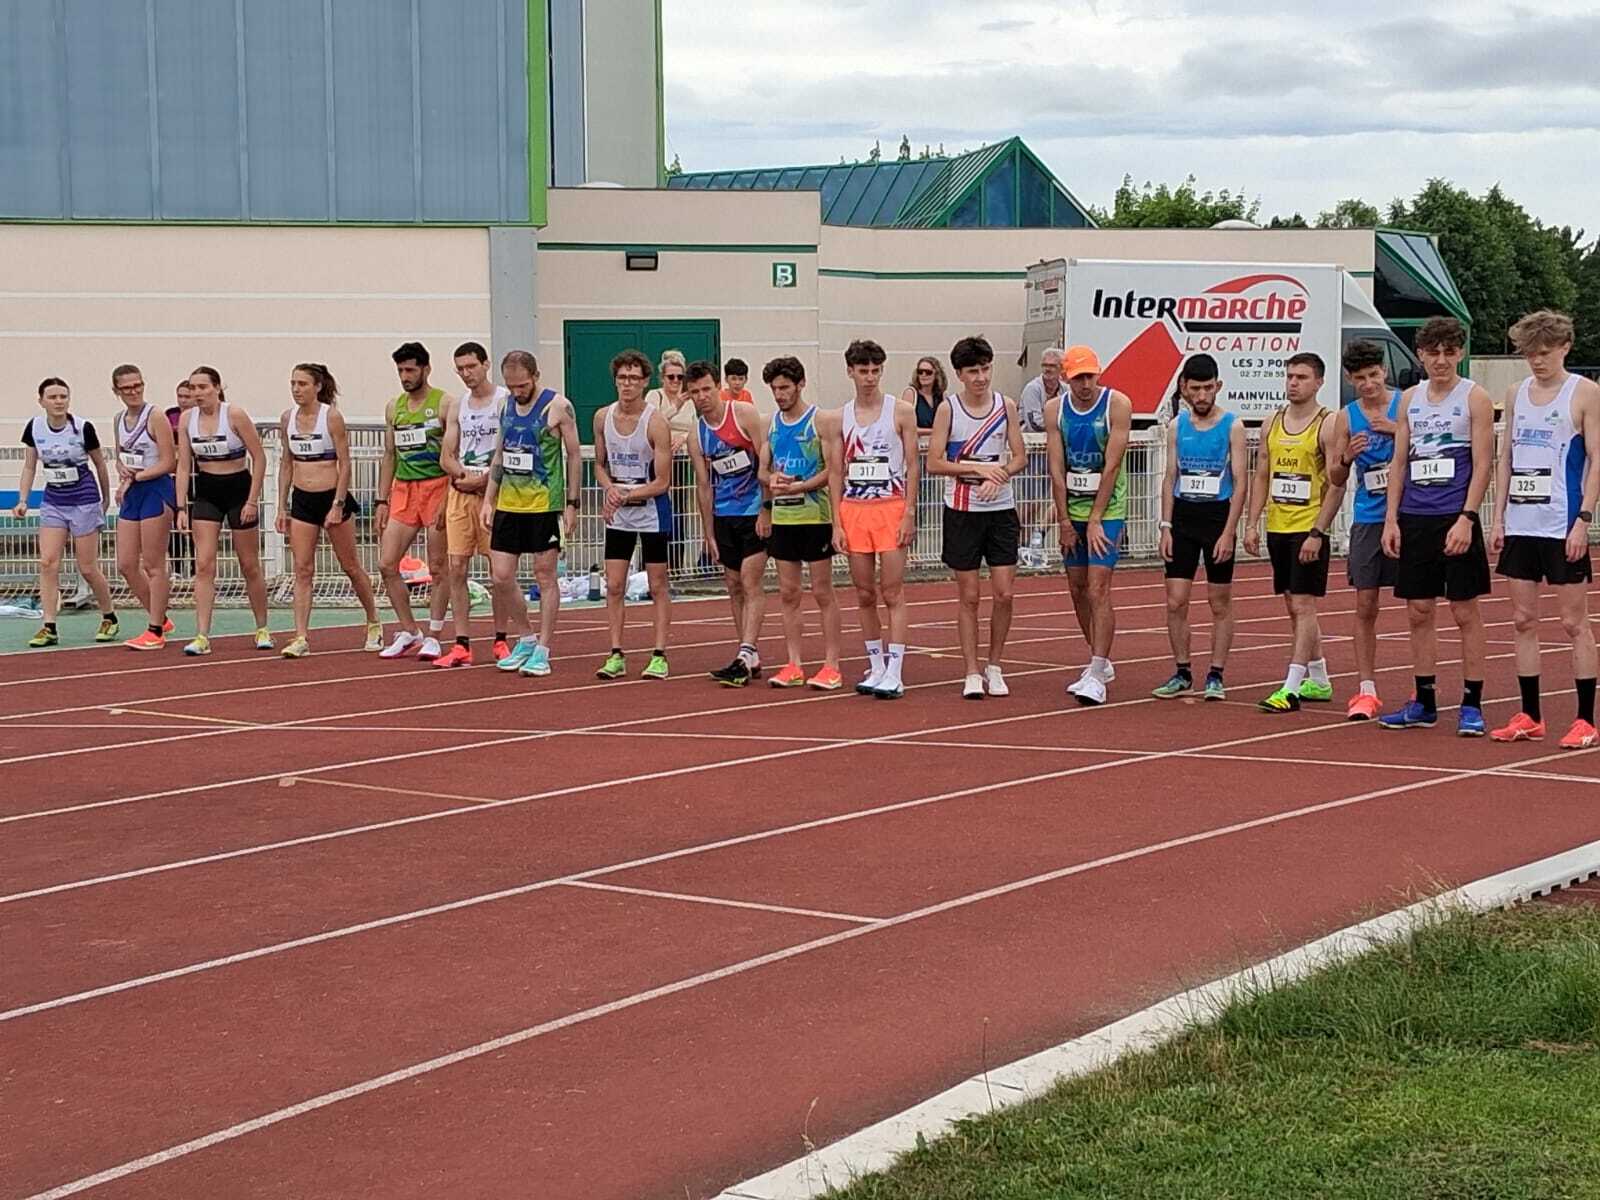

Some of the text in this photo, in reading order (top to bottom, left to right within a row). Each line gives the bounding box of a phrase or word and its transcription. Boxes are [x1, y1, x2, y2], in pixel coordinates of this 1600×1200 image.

[776, 265, 793, 286] B
[1093, 289, 1307, 332] Intermarché
[1185, 337, 1300, 351] LOCATION
[1232, 359, 1253, 368] LES
[1228, 392, 1286, 400] MAINVILLI
[860, 466, 875, 476] 317
[1422, 463, 1438, 475] 314
[1190, 479, 1205, 490] 321
[1517, 480, 1536, 491] 325
